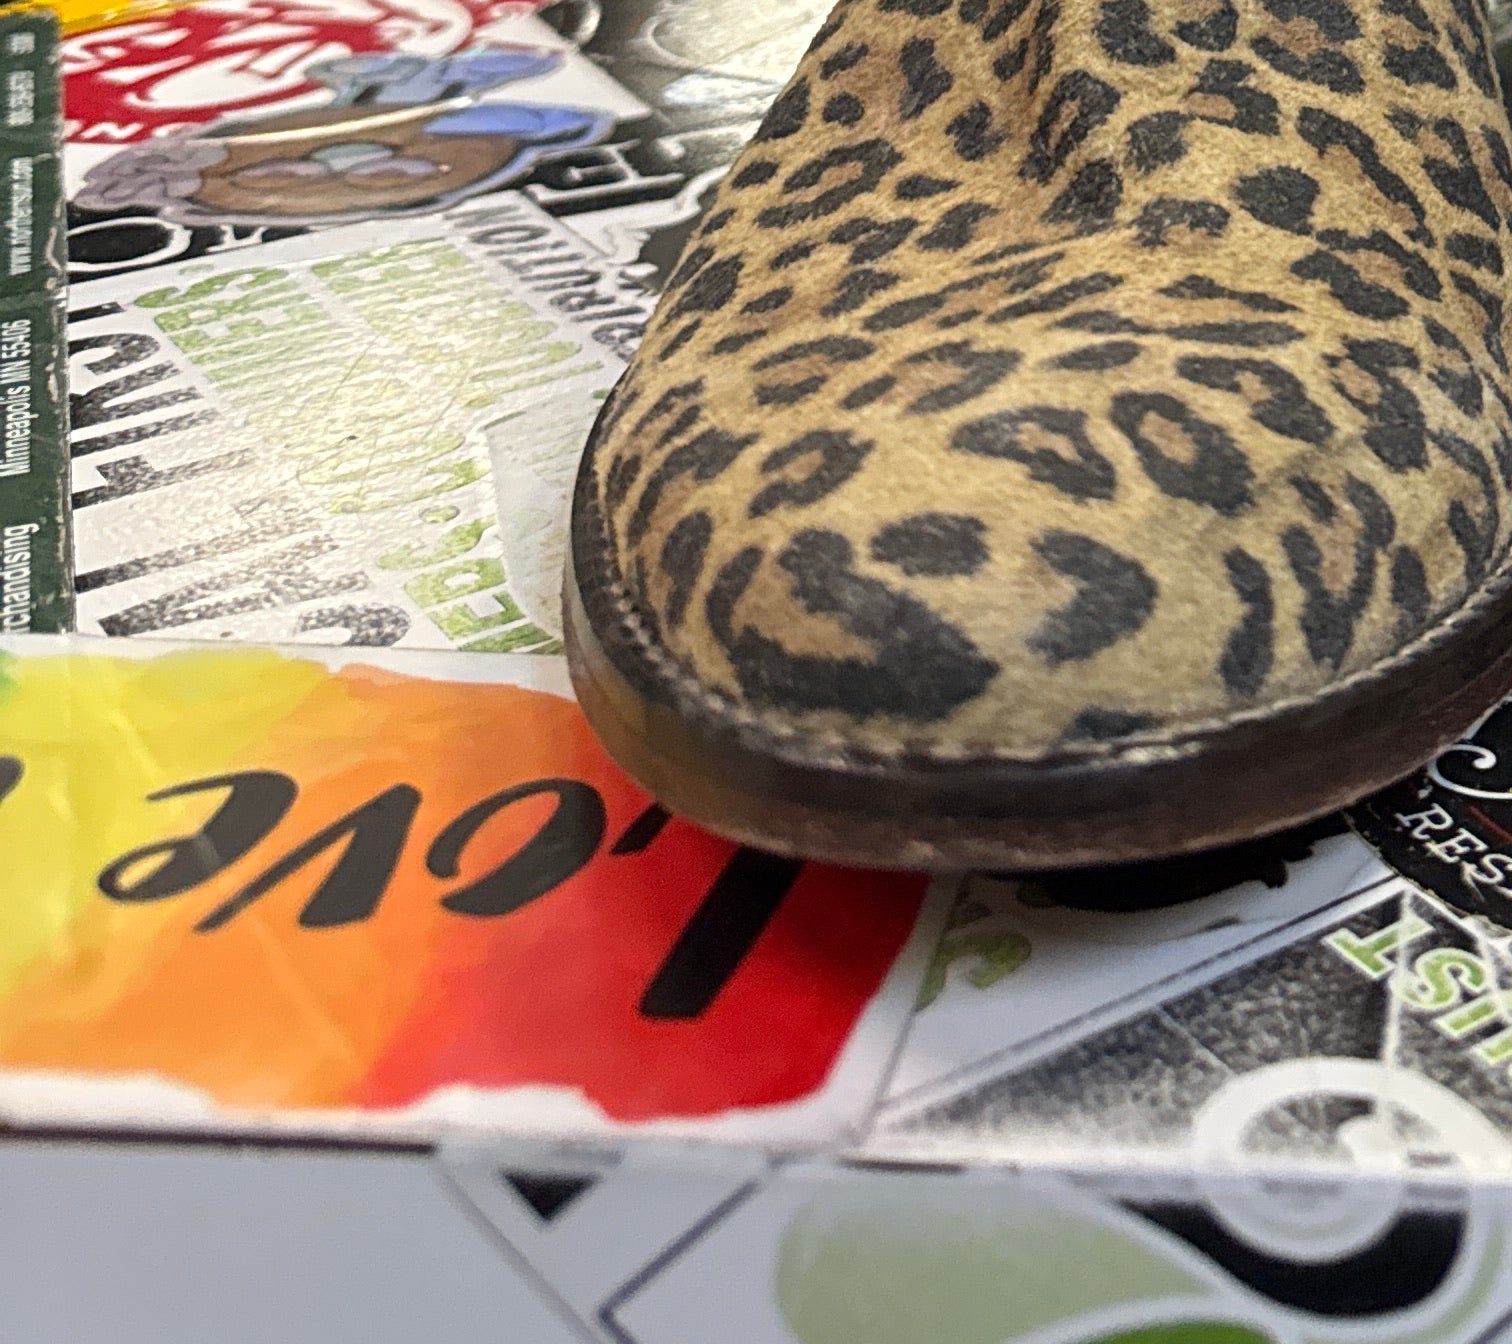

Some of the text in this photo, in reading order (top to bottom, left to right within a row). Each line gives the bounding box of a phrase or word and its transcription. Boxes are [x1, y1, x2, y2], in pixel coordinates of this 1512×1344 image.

[1, 319, 32, 360] 55406
[0, 386, 39, 478] Minneapolis
[97, 768, 804, 1020] Love
